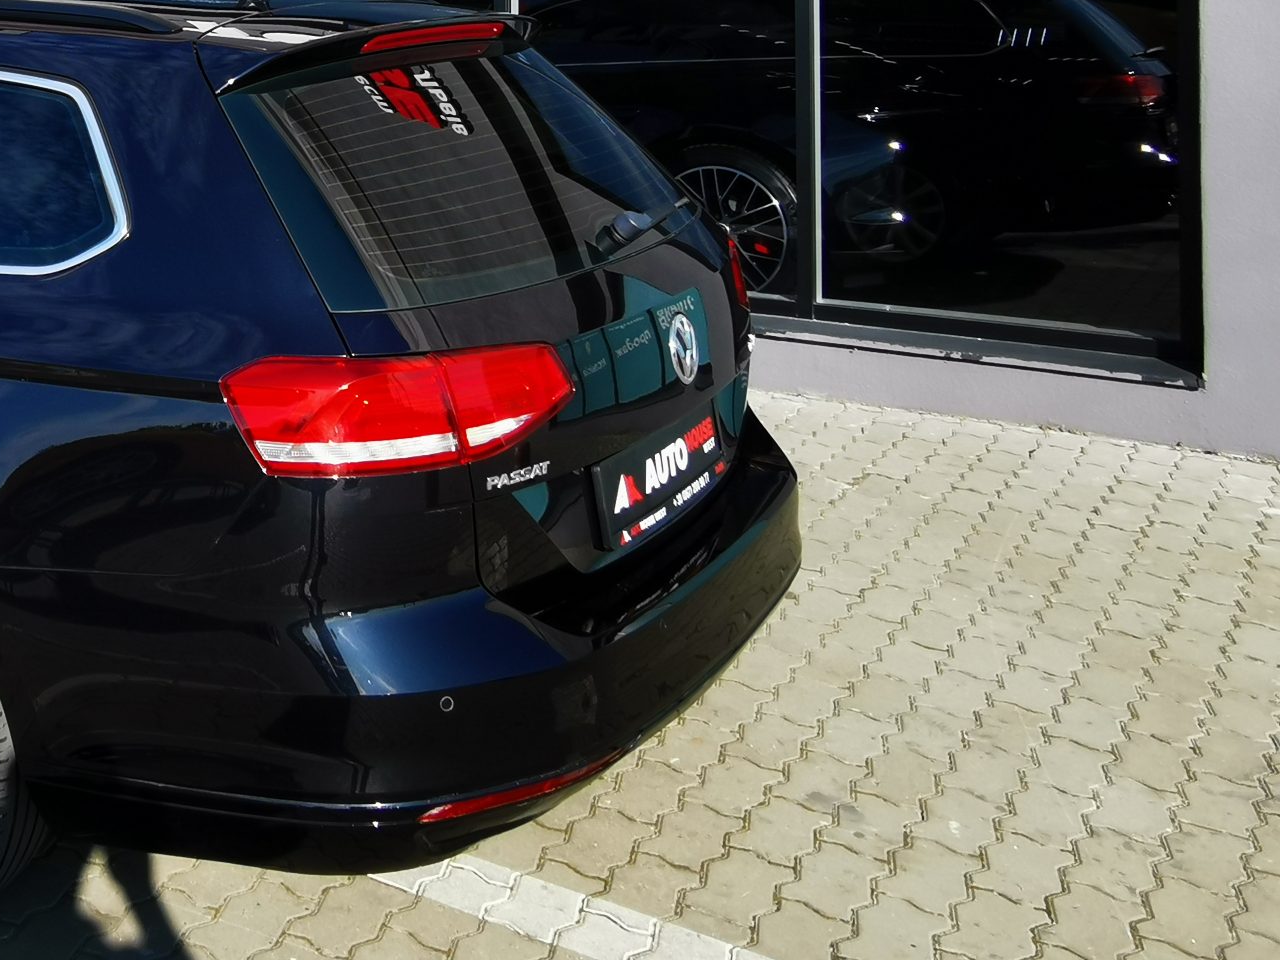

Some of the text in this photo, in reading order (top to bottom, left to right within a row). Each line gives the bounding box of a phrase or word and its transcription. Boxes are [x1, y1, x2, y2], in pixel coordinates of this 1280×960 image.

[486, 460, 551, 491] PASSAT
[645, 437, 689, 495] AUTO
[683, 416, 716, 454] HOUSE
